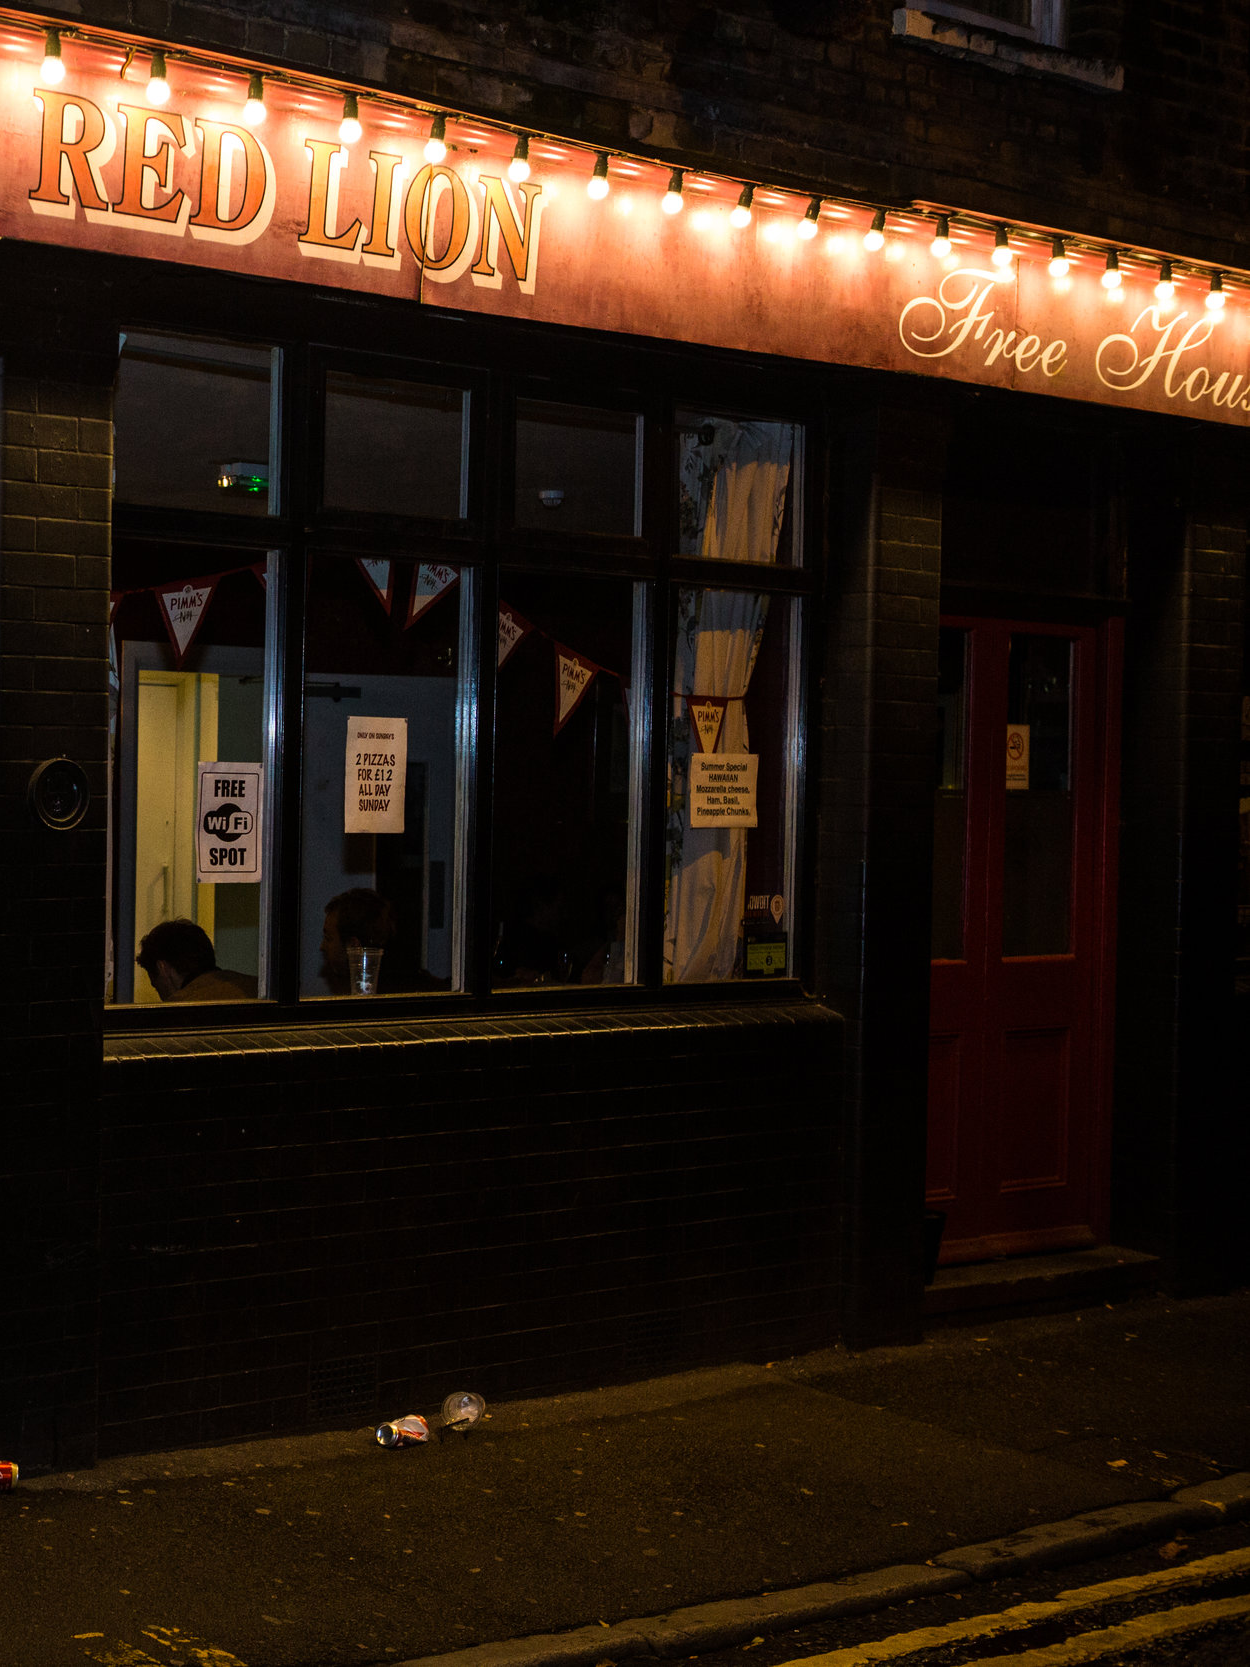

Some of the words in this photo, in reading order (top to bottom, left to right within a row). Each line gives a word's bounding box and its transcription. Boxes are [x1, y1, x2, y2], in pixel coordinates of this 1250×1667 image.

[29, 88, 276, 246] RED
[298, 138, 542, 295] LION
[899, 268, 1068, 377] Free
[170, 592, 203, 611] PIMM'S
[562, 663, 586, 685] PIMM'S
[697, 709, 719, 723] PIMM'S
[356, 753, 361, 766] 2
[363, 753, 395, 766] PIZZAS
[701, 762, 725, 771] Summer
[726, 762, 747, 771] Special
[358, 769, 372, 781] FOR
[375, 769, 392, 781] £12
[214, 780, 245, 797] FREE
[359, 784, 372, 796] ALL
[375, 784, 391, 796] DAY
[696, 785, 727, 794] Mozzarella
[358, 799, 390, 811] SUNDAY
[697, 807, 725, 816] Pineapple
[210, 847, 246, 865] SPOT
